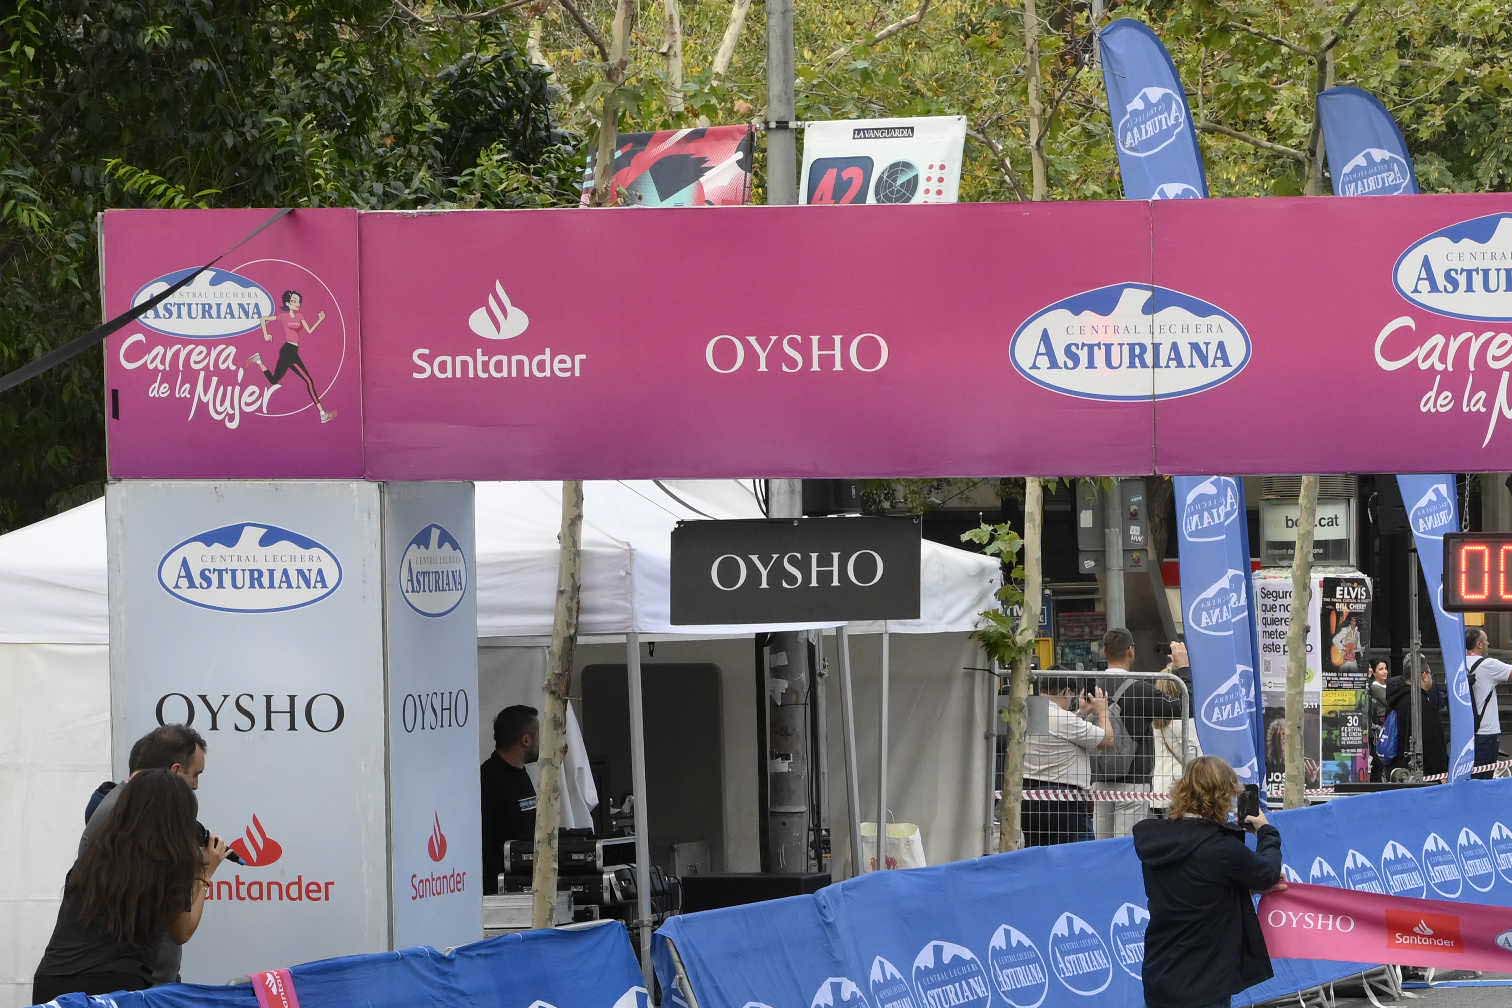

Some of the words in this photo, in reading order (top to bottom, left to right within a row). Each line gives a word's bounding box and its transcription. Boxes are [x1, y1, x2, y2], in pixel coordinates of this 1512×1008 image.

[1065, 325, 1141, 336] CENTRAL
[1148, 323, 1225, 335] LECHERA
[119, 333, 237, 371] Carrera
[412, 347, 587, 379] Santander
[705, 333, 889, 374] OYSHO
[1028, 328, 1233, 370] ASTURIANA
[149, 373, 171, 398] de
[175, 373, 191, 398] la
[188, 367, 283, 430] Mujer
[1420, 375, 1454, 414] de
[1462, 374, 1487, 413] la
[172, 556, 329, 590] ASTURIANA
[200, 554, 258, 564] CENTRAL
[264, 553, 323, 563] LECHERA
[710, 549, 885, 591] OYSHO
[405, 557, 464, 594] ASTURIANA
[1335, 586, 1367, 599] ELVIS
[1261, 604, 1278, 614] que
[1262, 643, 1281, 653] este
[155, 692, 346, 733] OYSHO
[402, 688, 469, 734] OYSHO
[1346, 715, 1359, 727] 30
[205, 875, 335, 902] antander
[410, 869, 466, 900] Santander
[1267, 909, 1356, 934] OYSHO
[1395, 931, 1455, 947] Santander
[993, 959, 1046, 992] ASTURIANA
[1055, 946, 1110, 978] ASTURIANA
